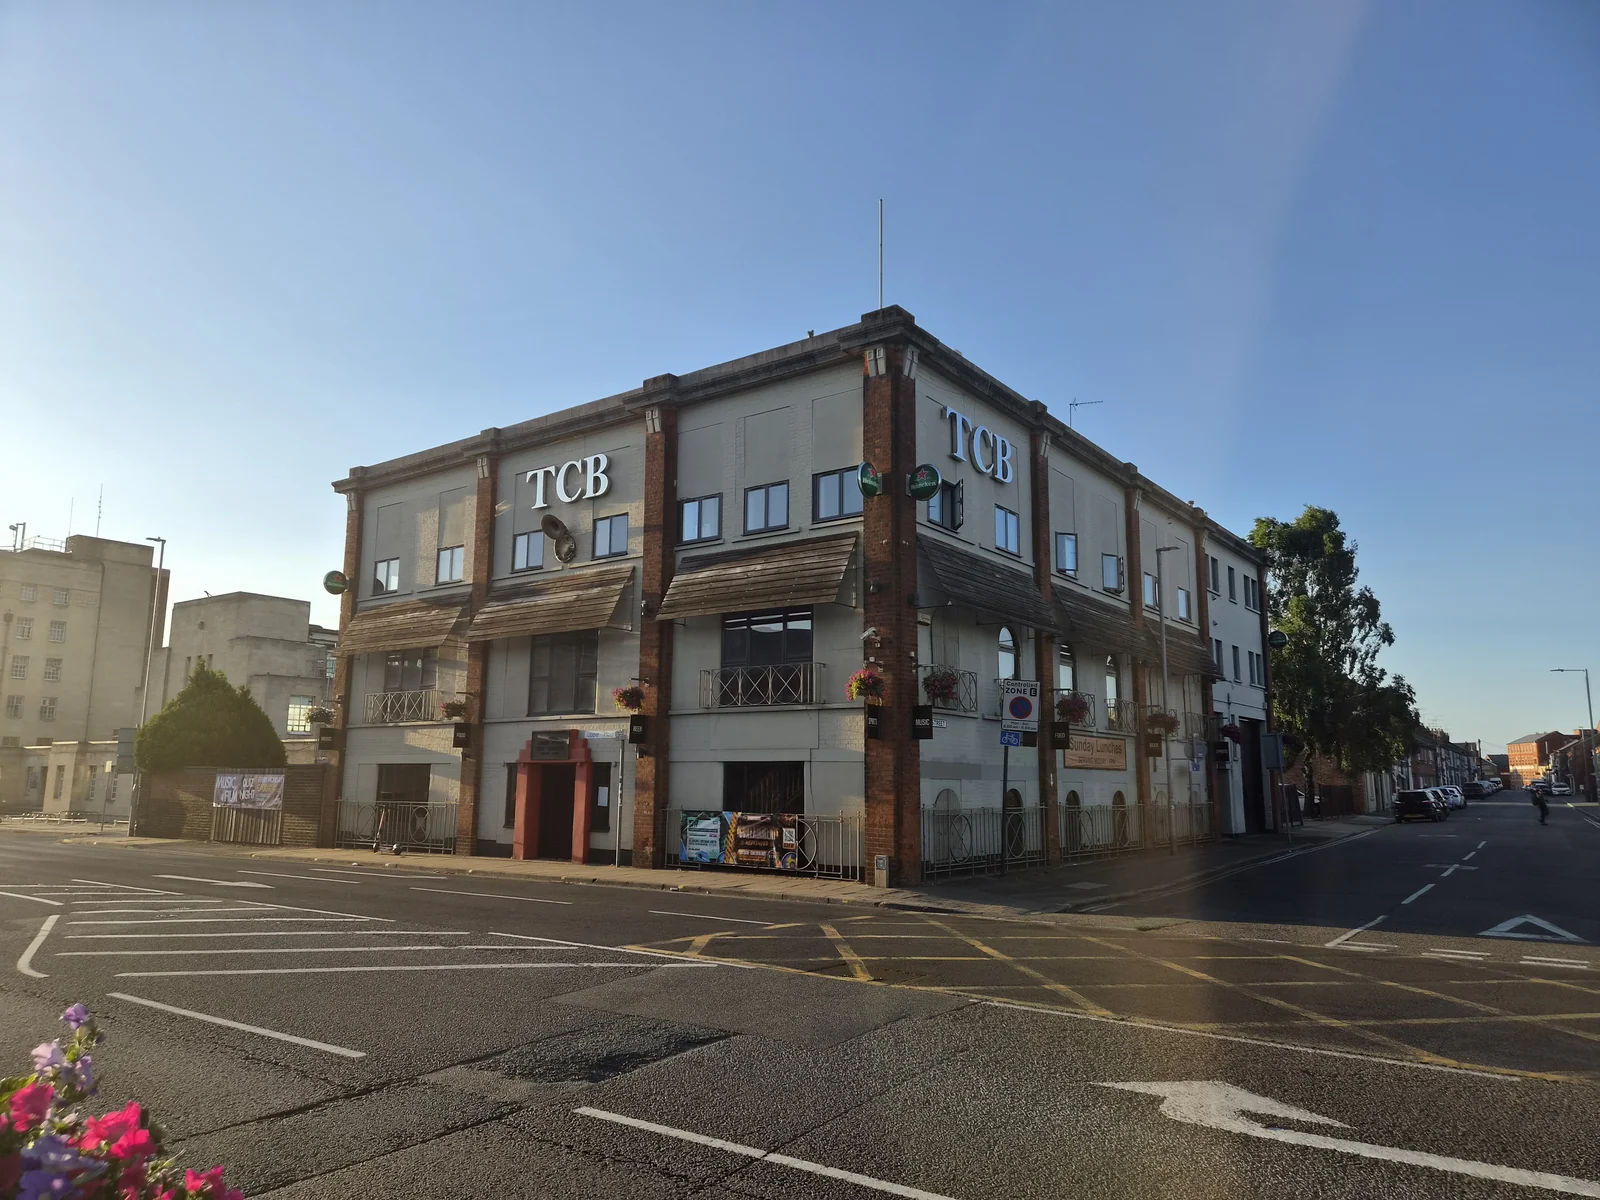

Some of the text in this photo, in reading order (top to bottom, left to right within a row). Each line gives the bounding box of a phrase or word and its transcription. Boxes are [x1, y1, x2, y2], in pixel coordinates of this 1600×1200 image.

[946, 405, 1013, 484] TCB
[525, 453, 609, 509] TCB
[910, 480, 937, 490] Heineken
[1005, 687, 1028, 695] ZONE
[915, 718, 930, 726] MUSIC
[1069, 737, 1122, 756] Sunday Lunches
[216, 776, 237, 789] MUSIC
[242, 777, 255, 788] QUIZ
[224, 790, 238, 802] FILM
[239, 789, 256, 800] NIGHT
